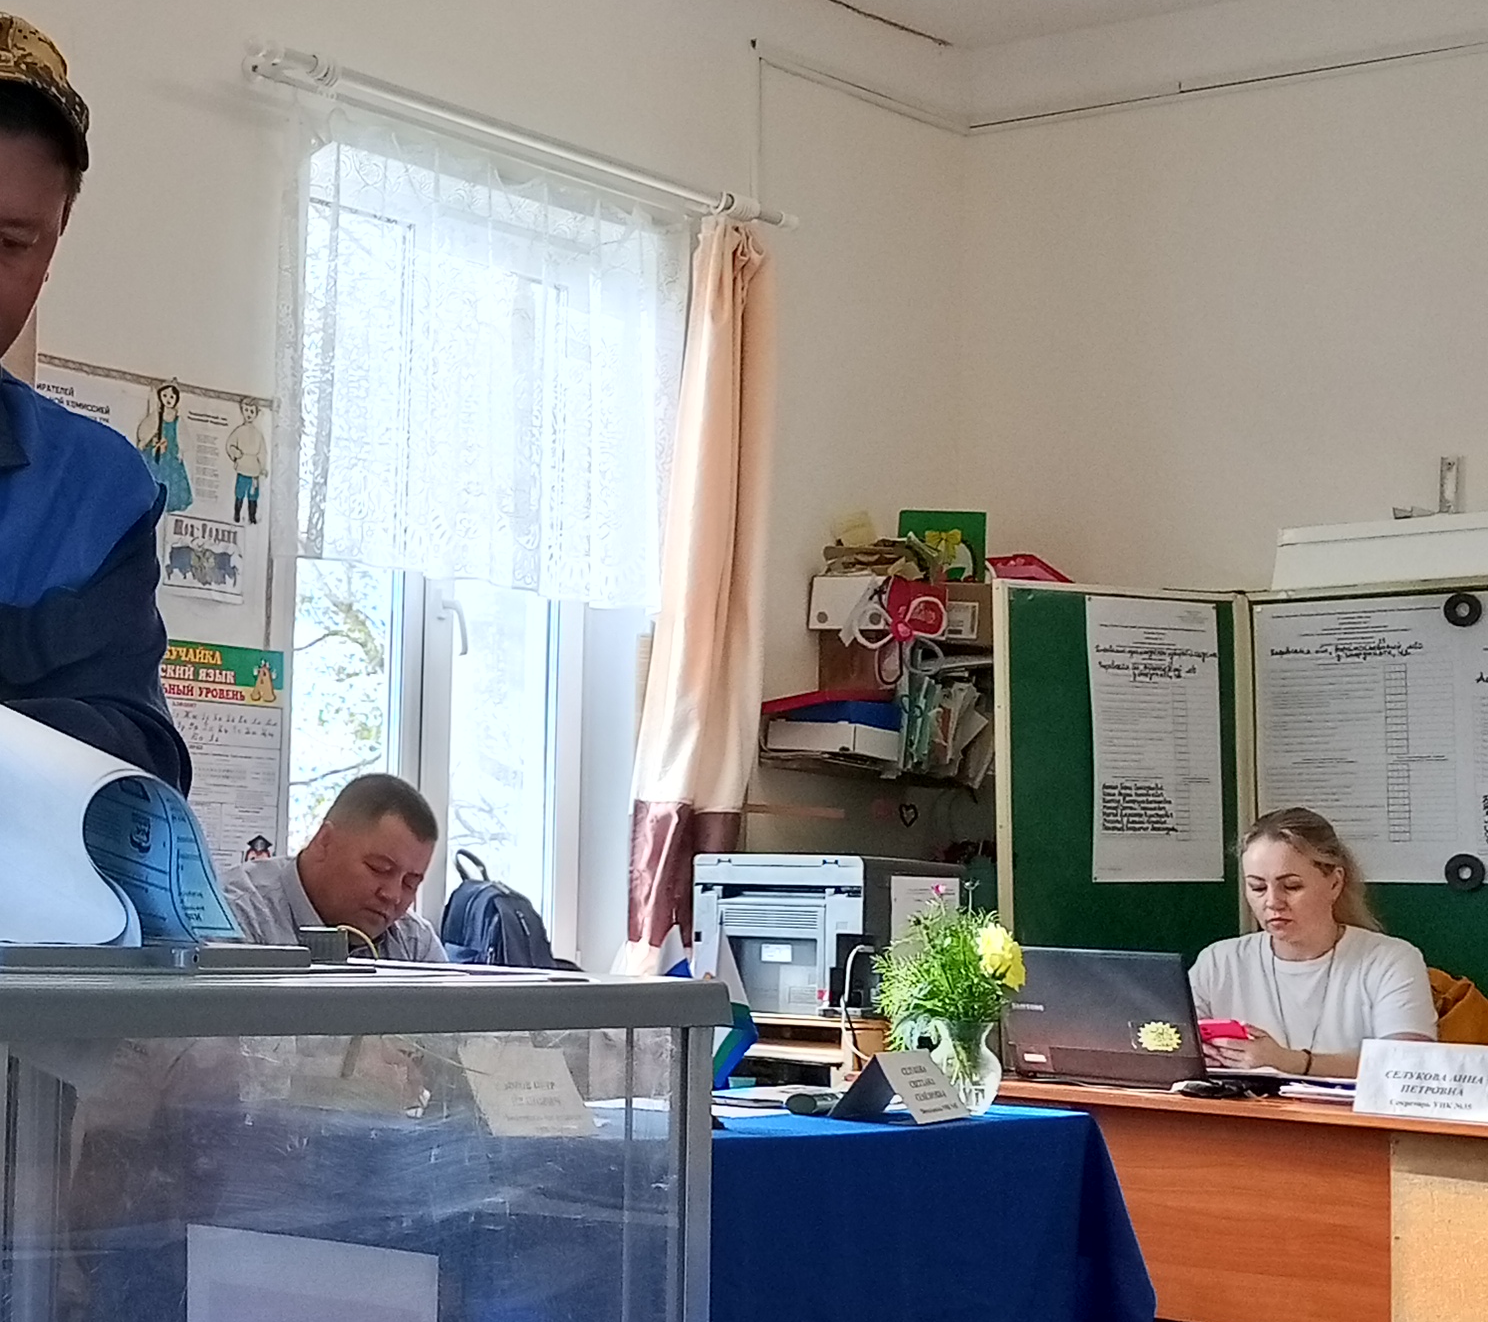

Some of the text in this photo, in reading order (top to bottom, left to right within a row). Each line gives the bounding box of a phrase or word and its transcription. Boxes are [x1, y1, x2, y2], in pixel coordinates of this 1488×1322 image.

[65, 399, 111, 415] КОМИССИЕЙ
[198, 667, 235, 684] ЯЗЫК
[198, 686, 246, 702] УРОВЕНЬ
[1400, 1084, 1464, 1097] ПЕТРОВНА
